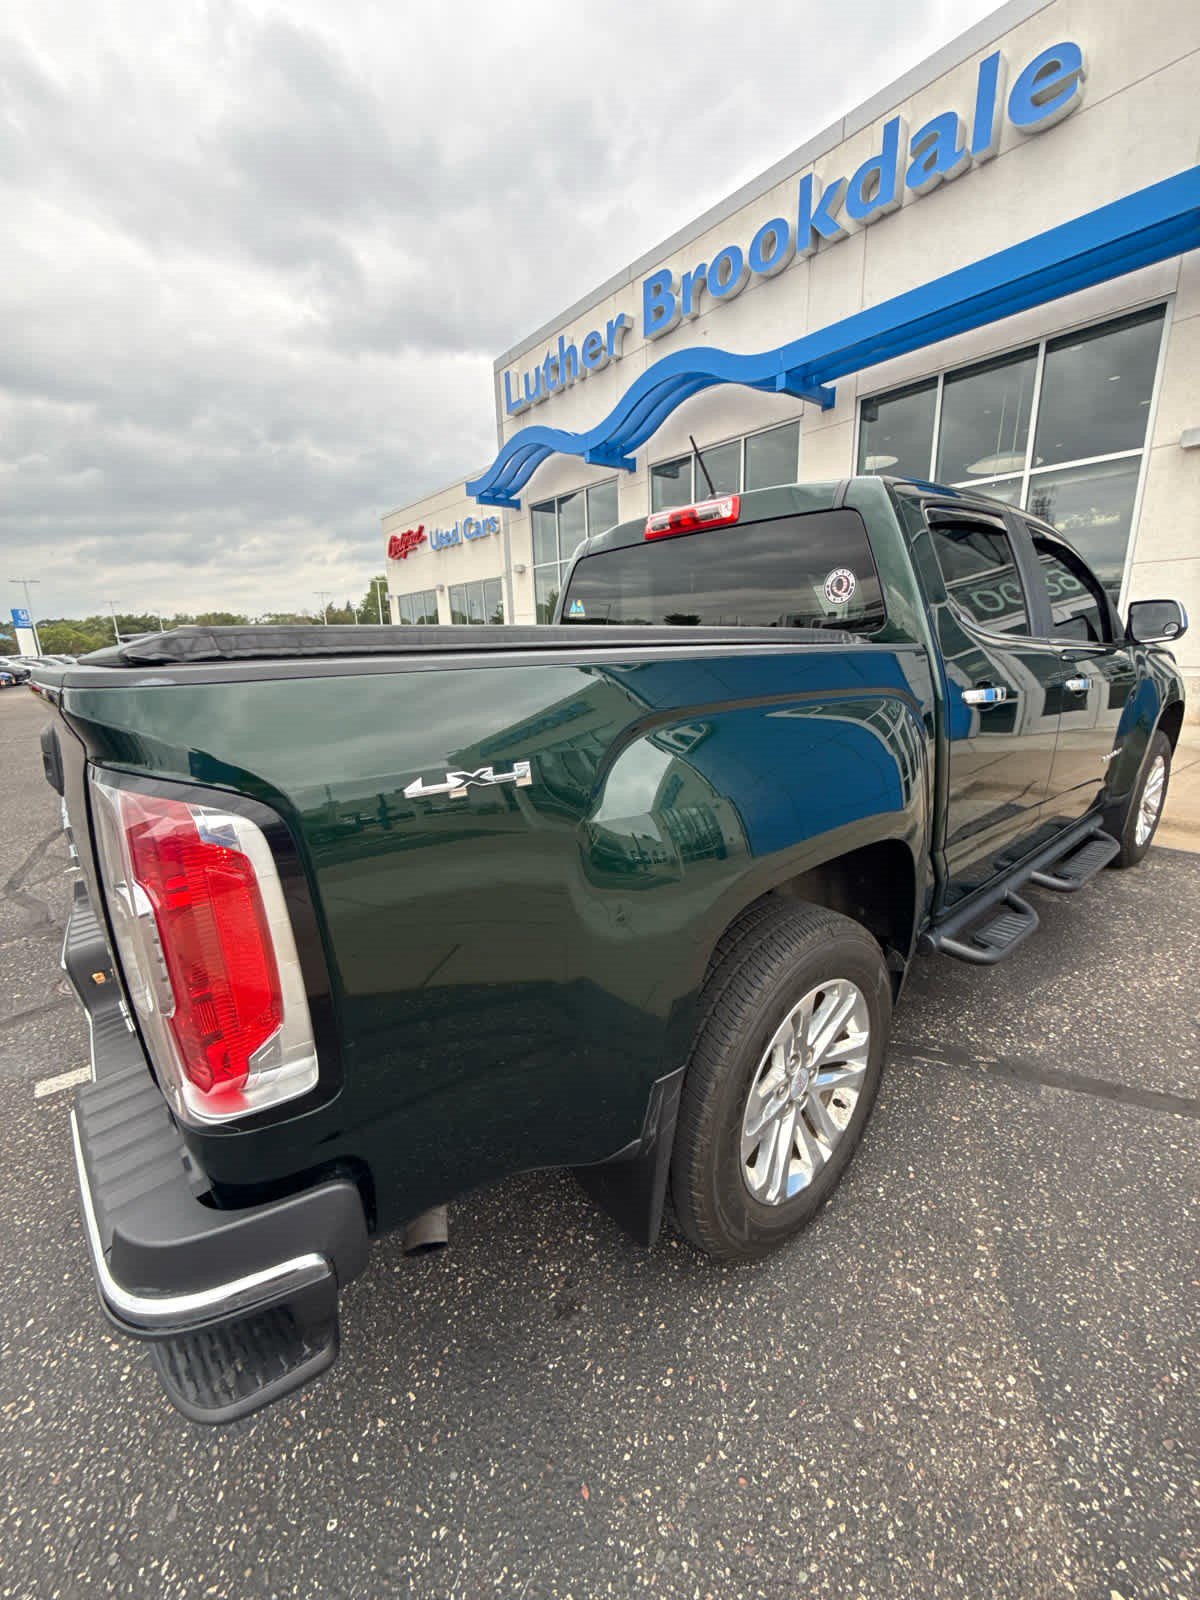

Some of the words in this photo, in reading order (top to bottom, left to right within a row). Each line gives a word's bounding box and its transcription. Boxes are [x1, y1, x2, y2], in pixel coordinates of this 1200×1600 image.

[504, 312, 632, 416] Luther
[642, 40, 1087, 340] Brookdale
[429, 521, 463, 550] Used
[463, 515, 499, 540] Cars
